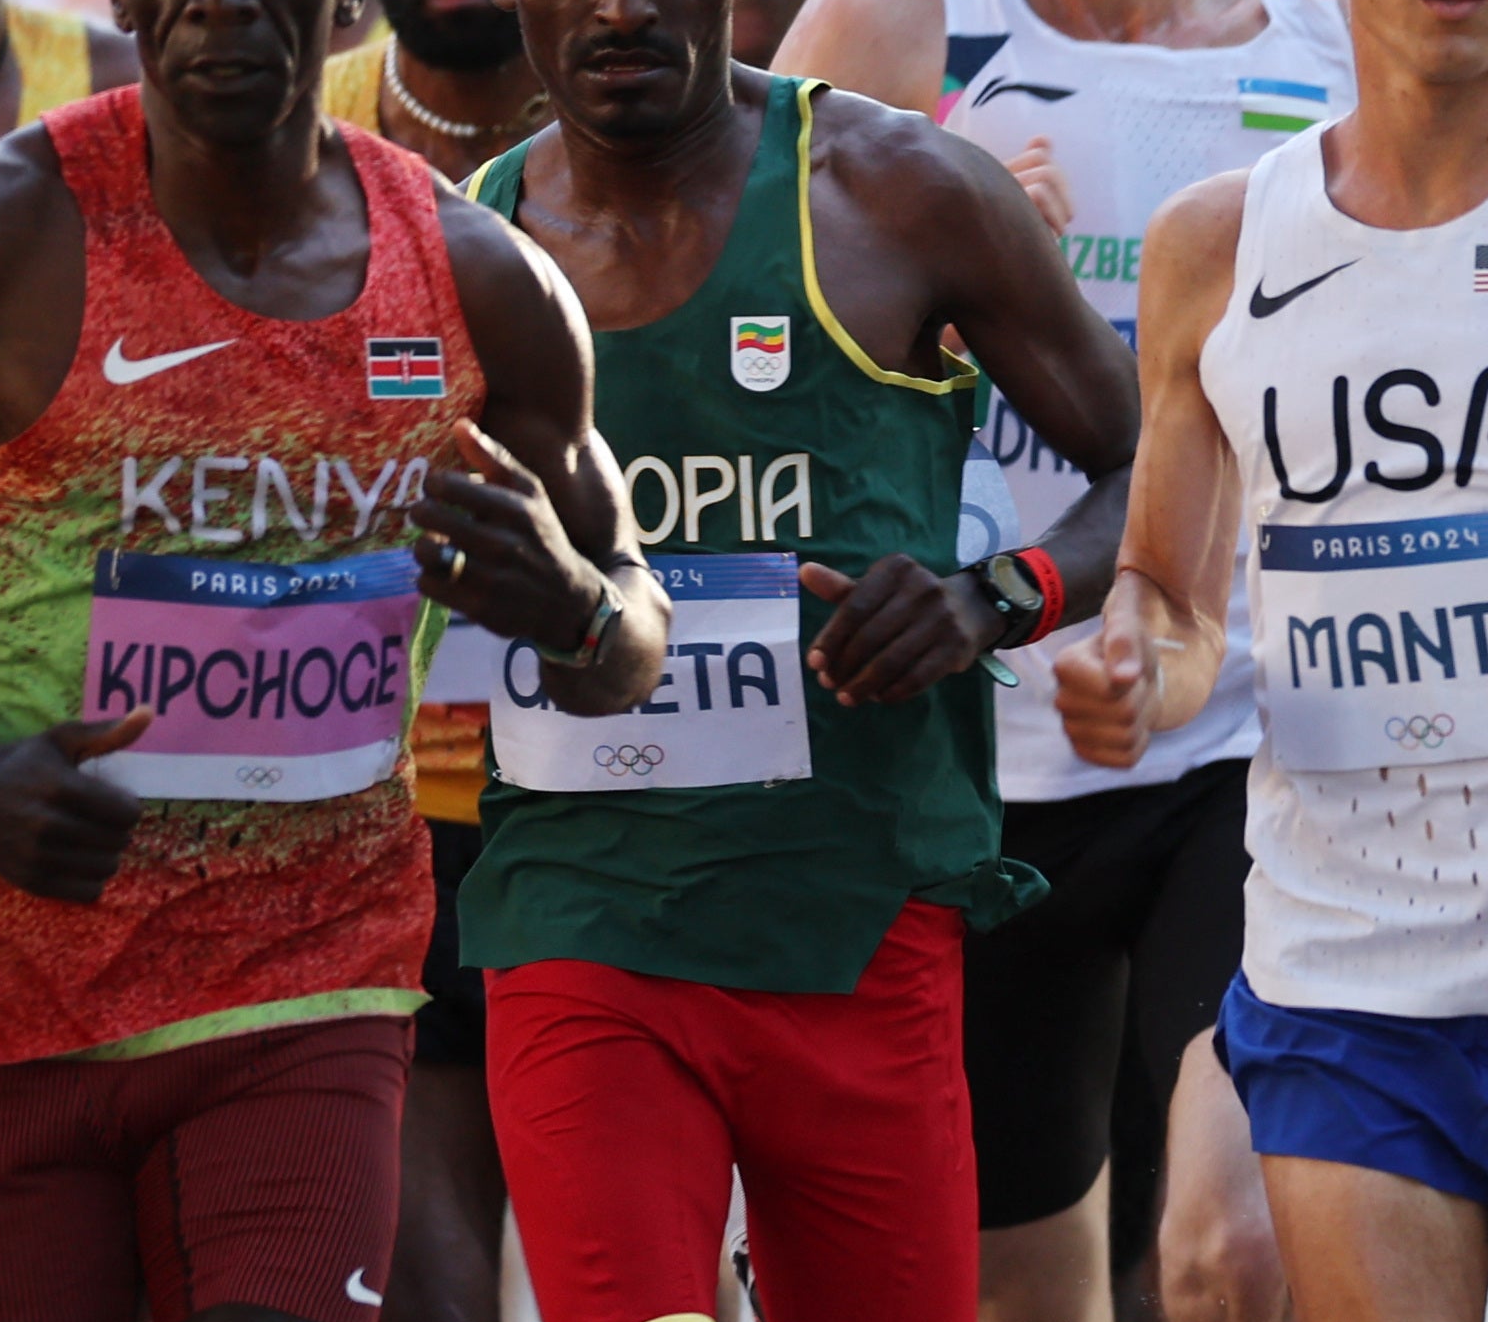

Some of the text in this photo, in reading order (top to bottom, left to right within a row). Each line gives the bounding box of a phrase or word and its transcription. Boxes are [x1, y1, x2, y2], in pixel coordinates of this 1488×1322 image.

[1313, 528, 1480, 560] PARIS 2024
[191, 570, 357, 596] PARIS 2024
[98, 635, 403, 720] KIPCHOGE
